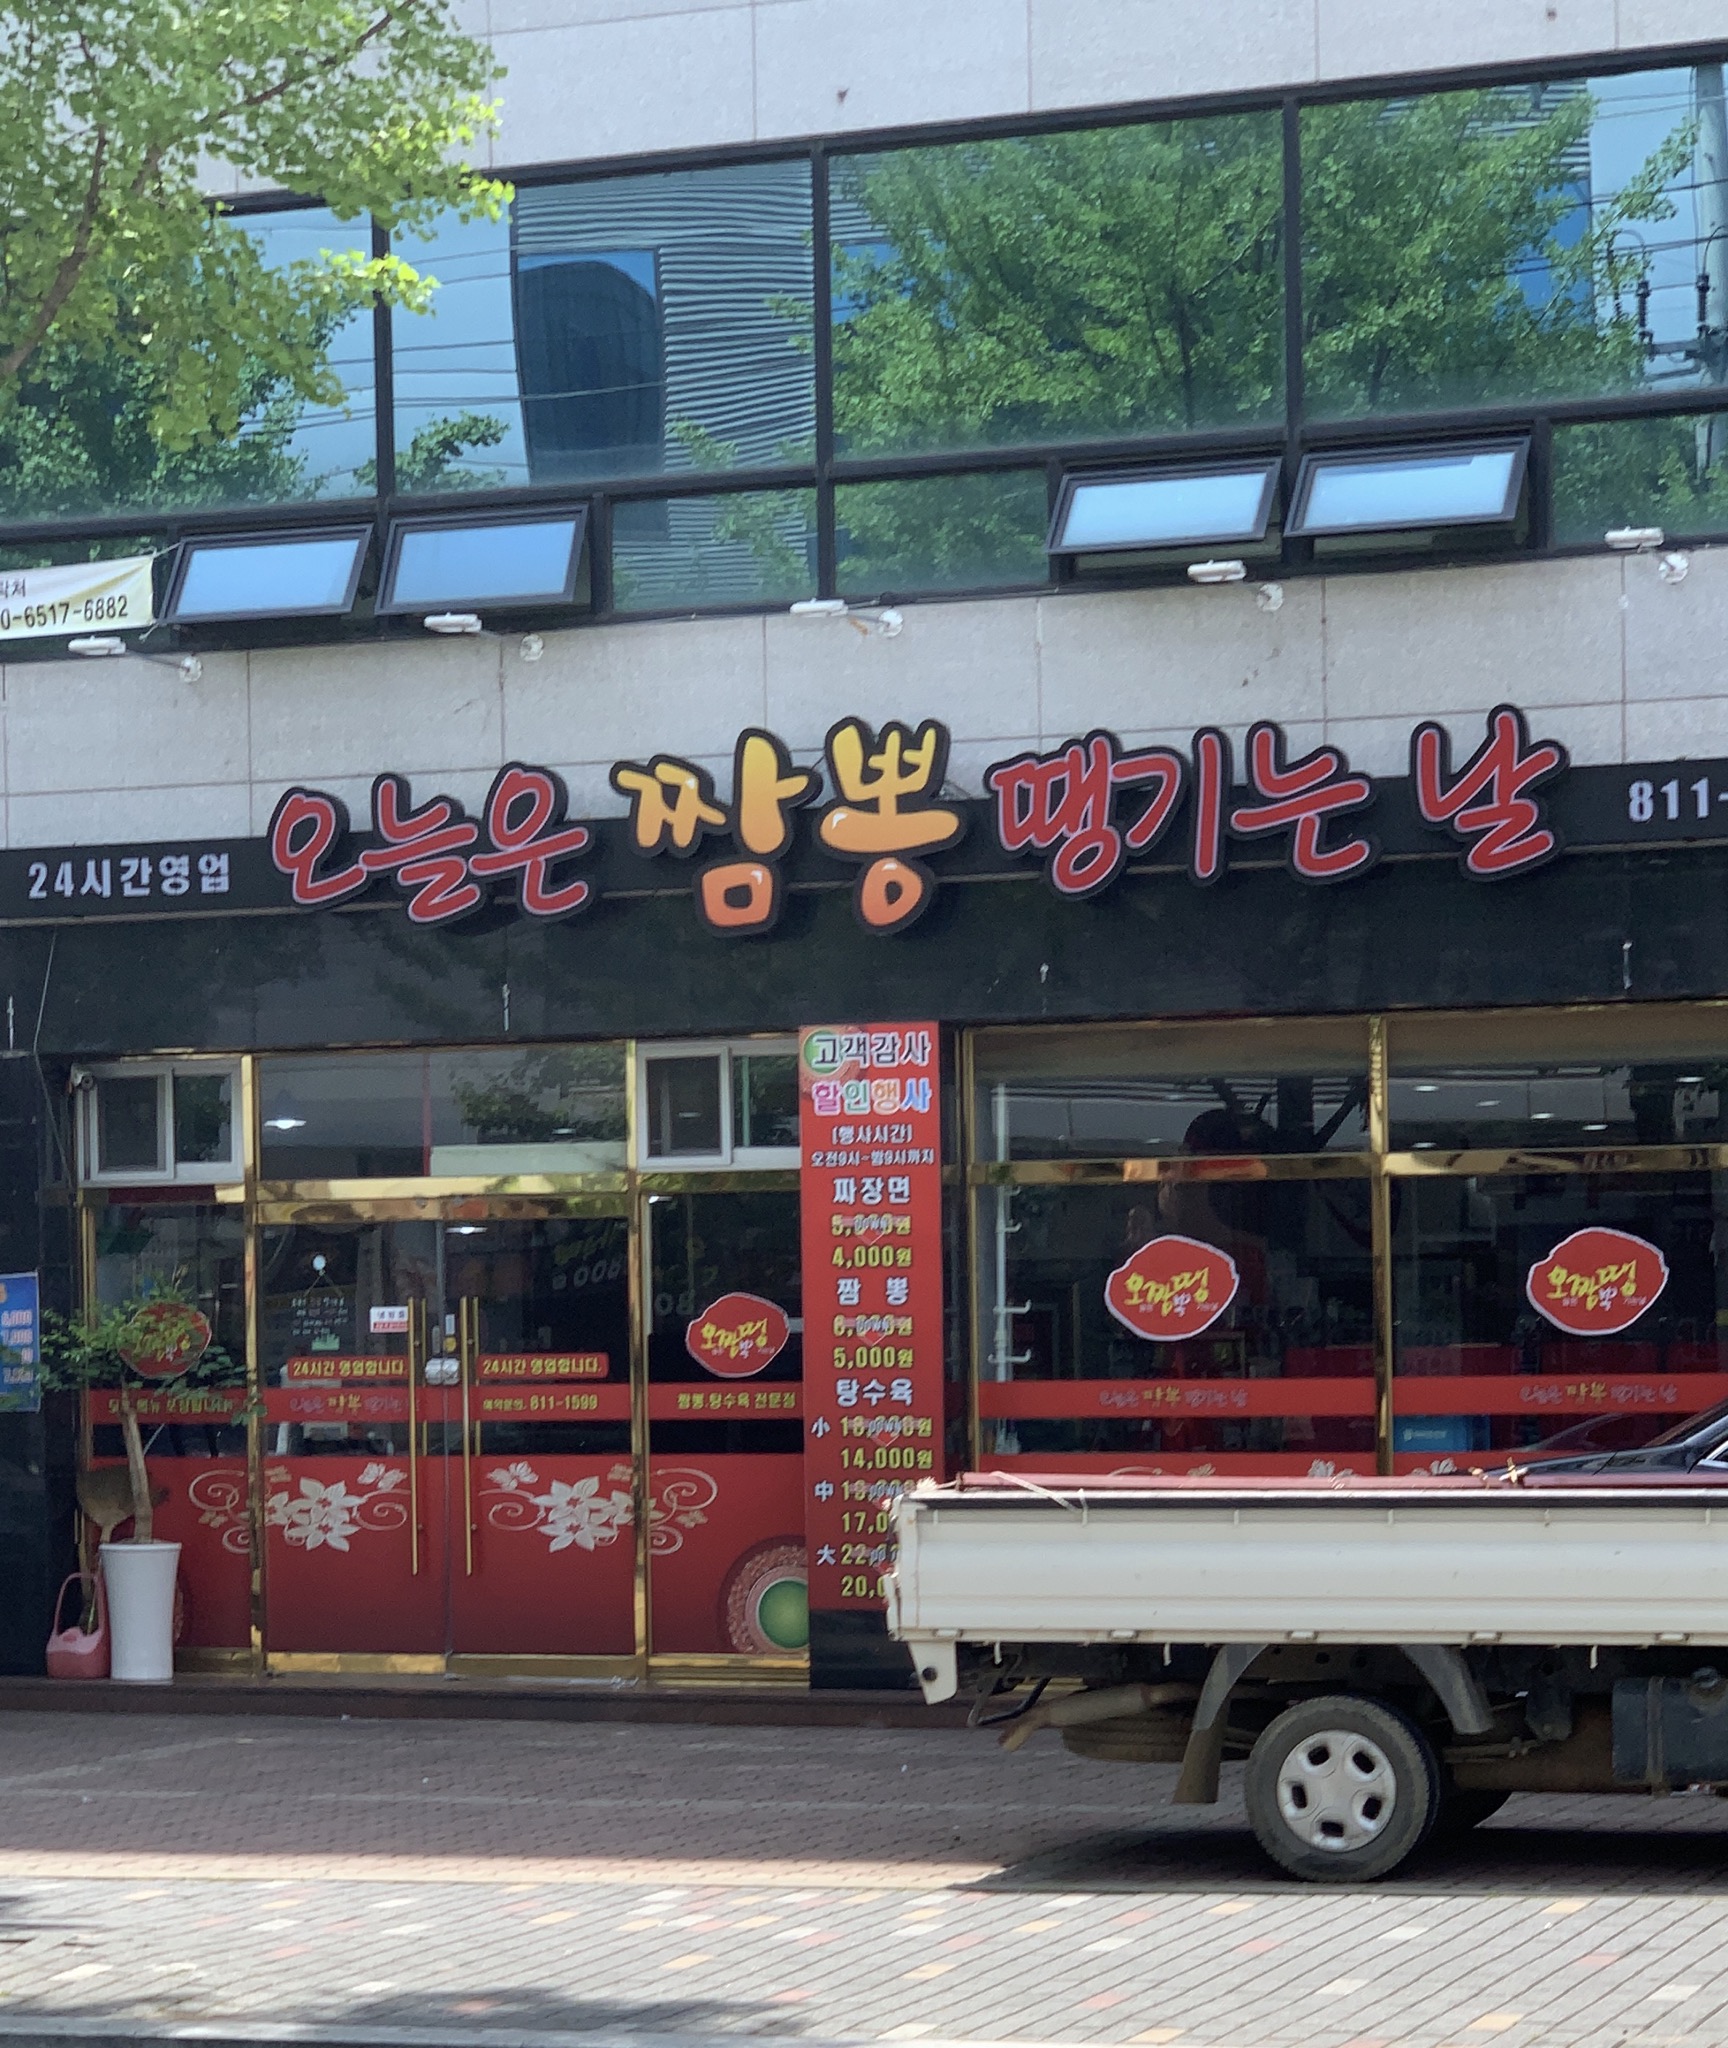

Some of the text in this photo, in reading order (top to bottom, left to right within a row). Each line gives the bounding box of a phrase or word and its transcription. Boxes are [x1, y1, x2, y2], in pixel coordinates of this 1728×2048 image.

[0, 594, 128, 630] 0-6517-6882
[268, 709, 1561, 929] 오늘은 짬뽕 땡기는 날
[28, 853, 231, 899] 24시간영업
[812, 1031, 931, 1068] 고객감사
[812, 1077, 932, 1115] 할인행사
[833, 1176, 910, 1205] 짜장면
[832, 1246, 912, 1268] 4,000원
[834, 1346, 913, 1370] 5,000원
[836, 1378, 913, 1407] 탕수육
[811, 1416, 831, 1438] 小
[841, 1447, 932, 1470] 14,000원
[814, 1480, 834, 1502] 中
[816, 1544, 836, 1566] 大
